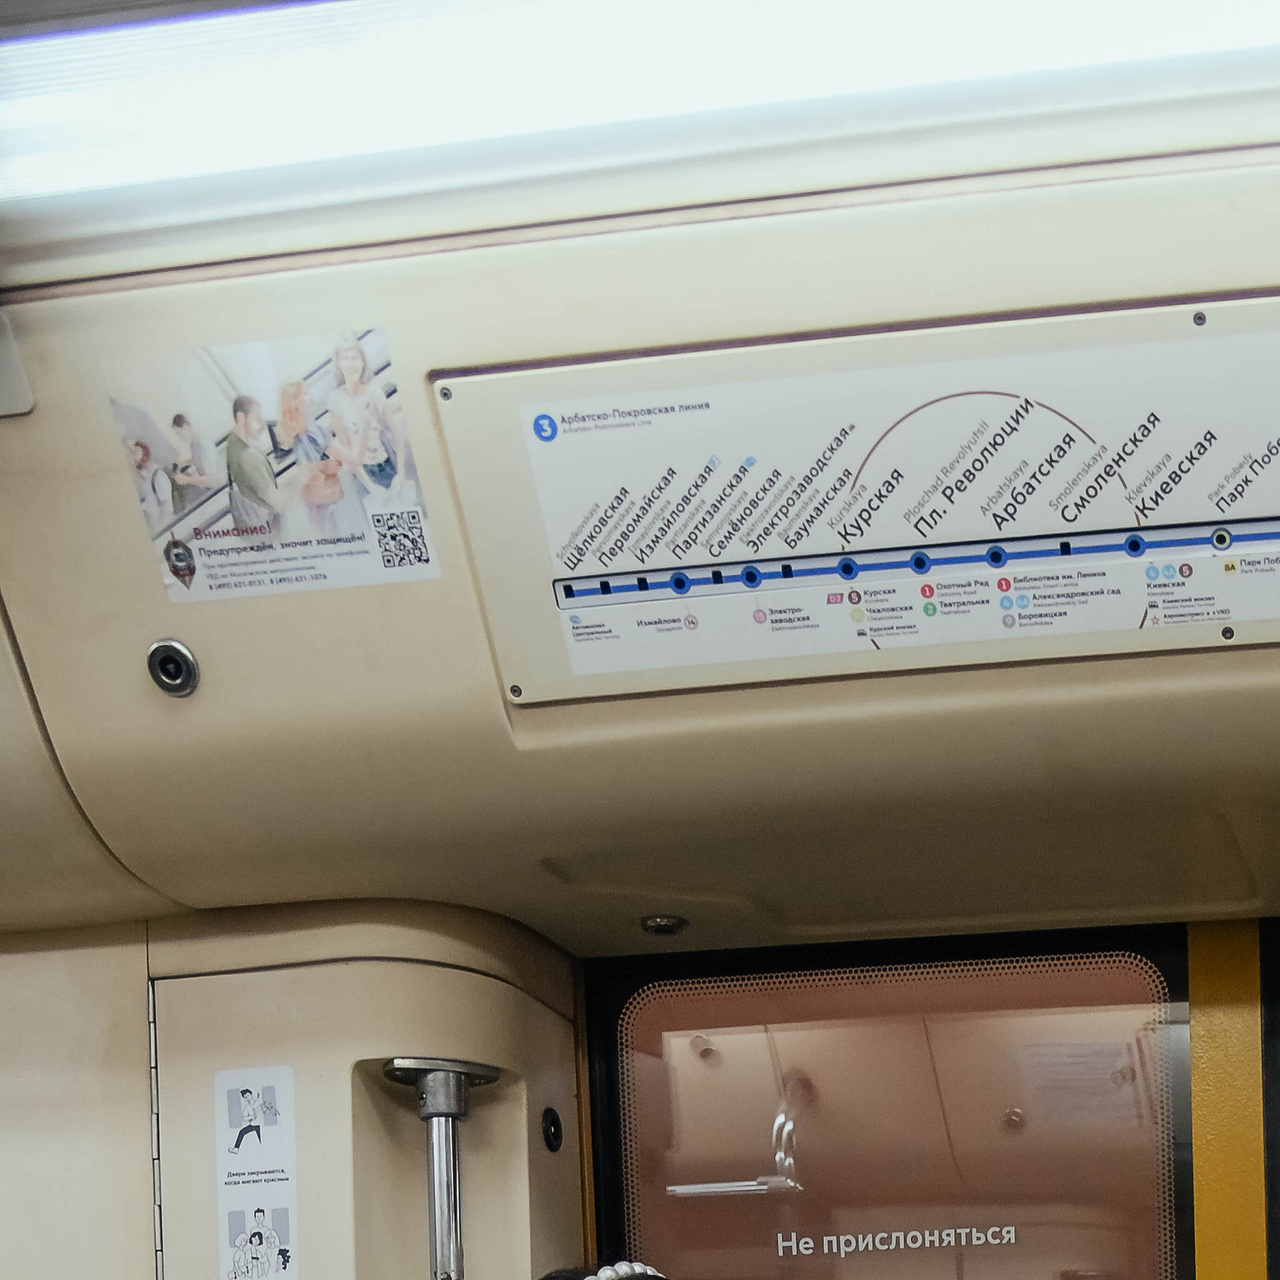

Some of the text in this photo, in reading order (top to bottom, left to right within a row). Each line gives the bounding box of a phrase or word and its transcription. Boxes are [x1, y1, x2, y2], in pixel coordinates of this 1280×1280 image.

[561, 406, 675, 425] Арбатско-Покровская
[678, 402, 711, 413] линия
[746, 427, 850, 554] Электрозаводская
[783, 468, 853, 550] Бауманская
[836, 468, 905, 544] Курская
[913, 397, 1035, 539] Пл. Революции
[991, 432, 1076, 531] Арбатская
[1060, 412, 1161, 524] Смоленская
[1135, 430, 1218, 519] Киевская
[1215, 474, 1253, 514] Парк
[193, 521, 271, 541] Внимание!
[280, 540, 313, 548] значит
[315, 533, 366, 546] защищён!
[563, 487, 630, 571] Щёлковская
[598, 467, 677, 568] Первомайская
[634, 465, 714, 564] Измайловская
[671, 464, 749, 560] Партизанская
[708, 468, 782, 558] Семёновская
[936, 581, 972, 591] Охотный
[974, 580, 989, 588] Ряд
[1013, 575, 1060, 584] Библиотека
[1032, 588, 1105, 601] Александровский
[1240, 559, 1261, 567] Парк
[777, 1225, 1016, 1258] Не прислоняться
